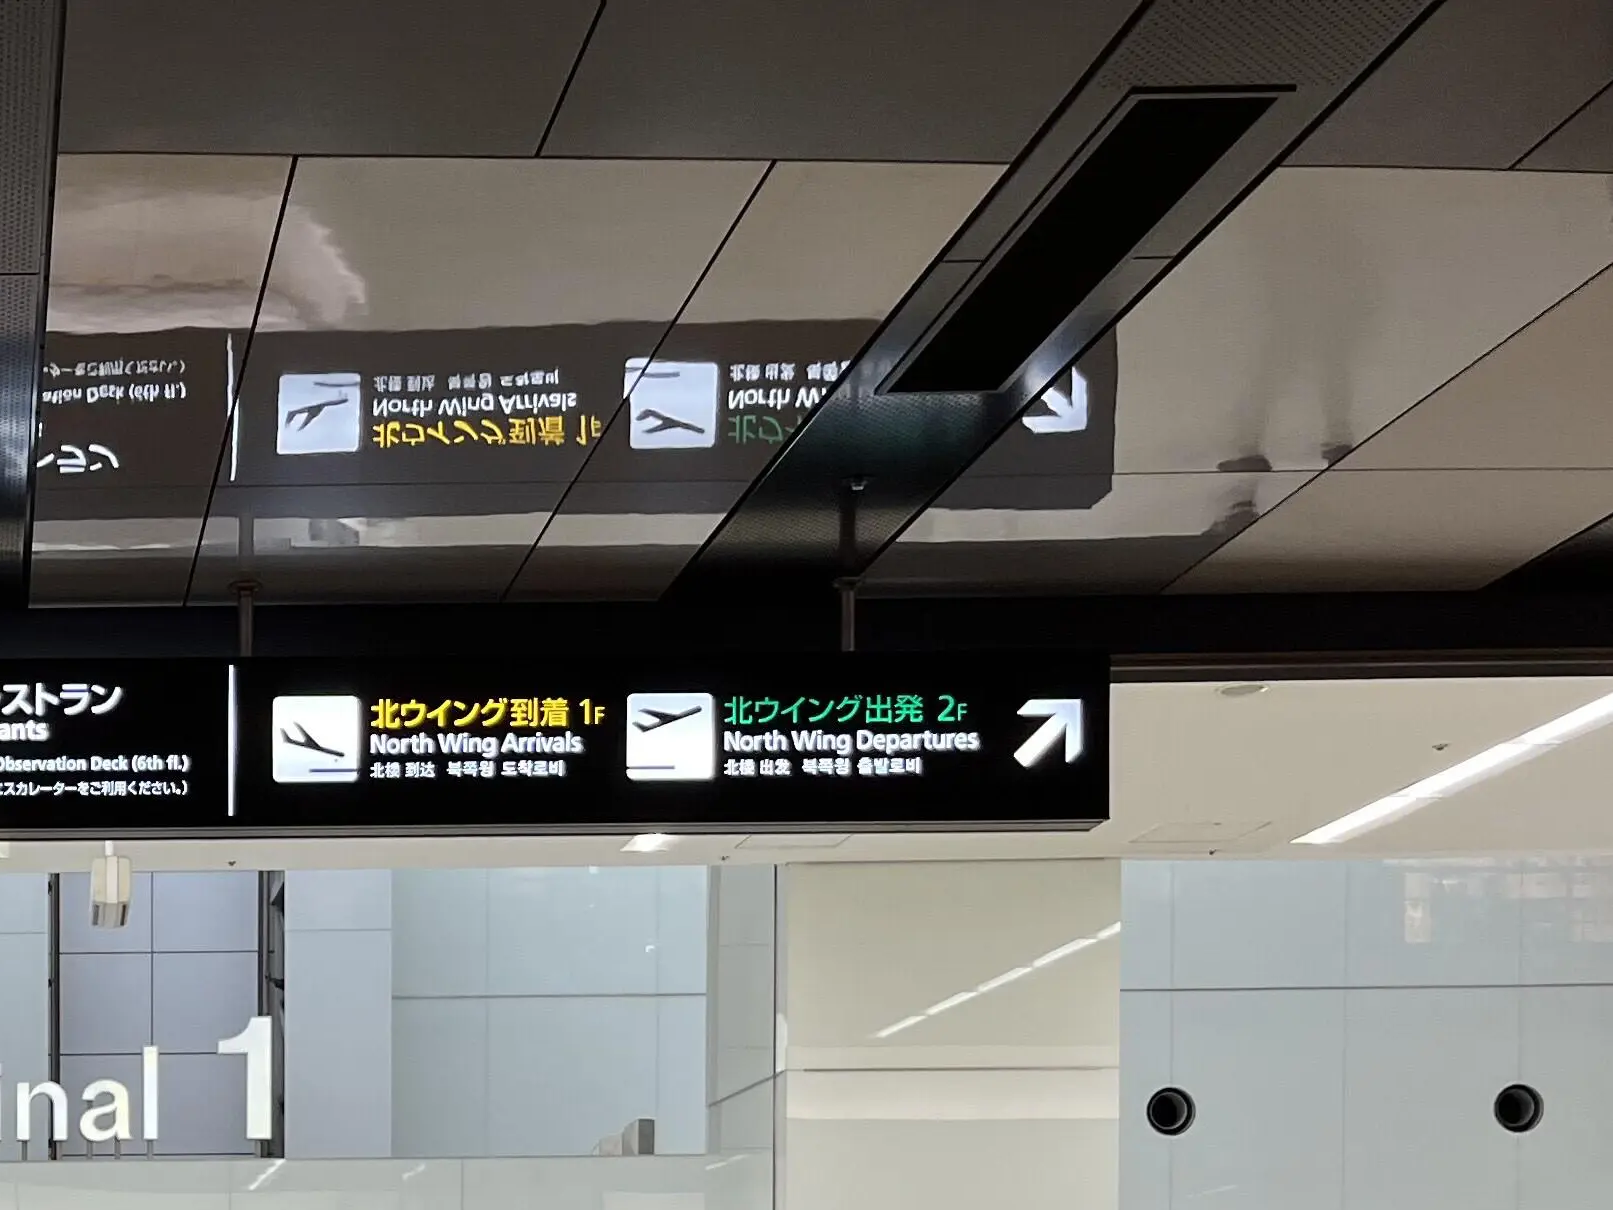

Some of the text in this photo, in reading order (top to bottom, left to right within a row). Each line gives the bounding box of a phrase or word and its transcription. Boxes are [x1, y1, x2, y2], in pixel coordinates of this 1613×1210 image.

[370, 697, 605, 729] 北ウイング到着 1F
[724, 694, 968, 725] 北ウイング出発 2F
[370, 731, 586, 759] North Wing Arrivals
[723, 729, 981, 756] North Wing Departures
[90, 755, 129, 772] Deck
[131, 754, 165, 773] (6th
[166, 754, 190, 773] fl.)
[217, 1016, 274, 1141] 1
